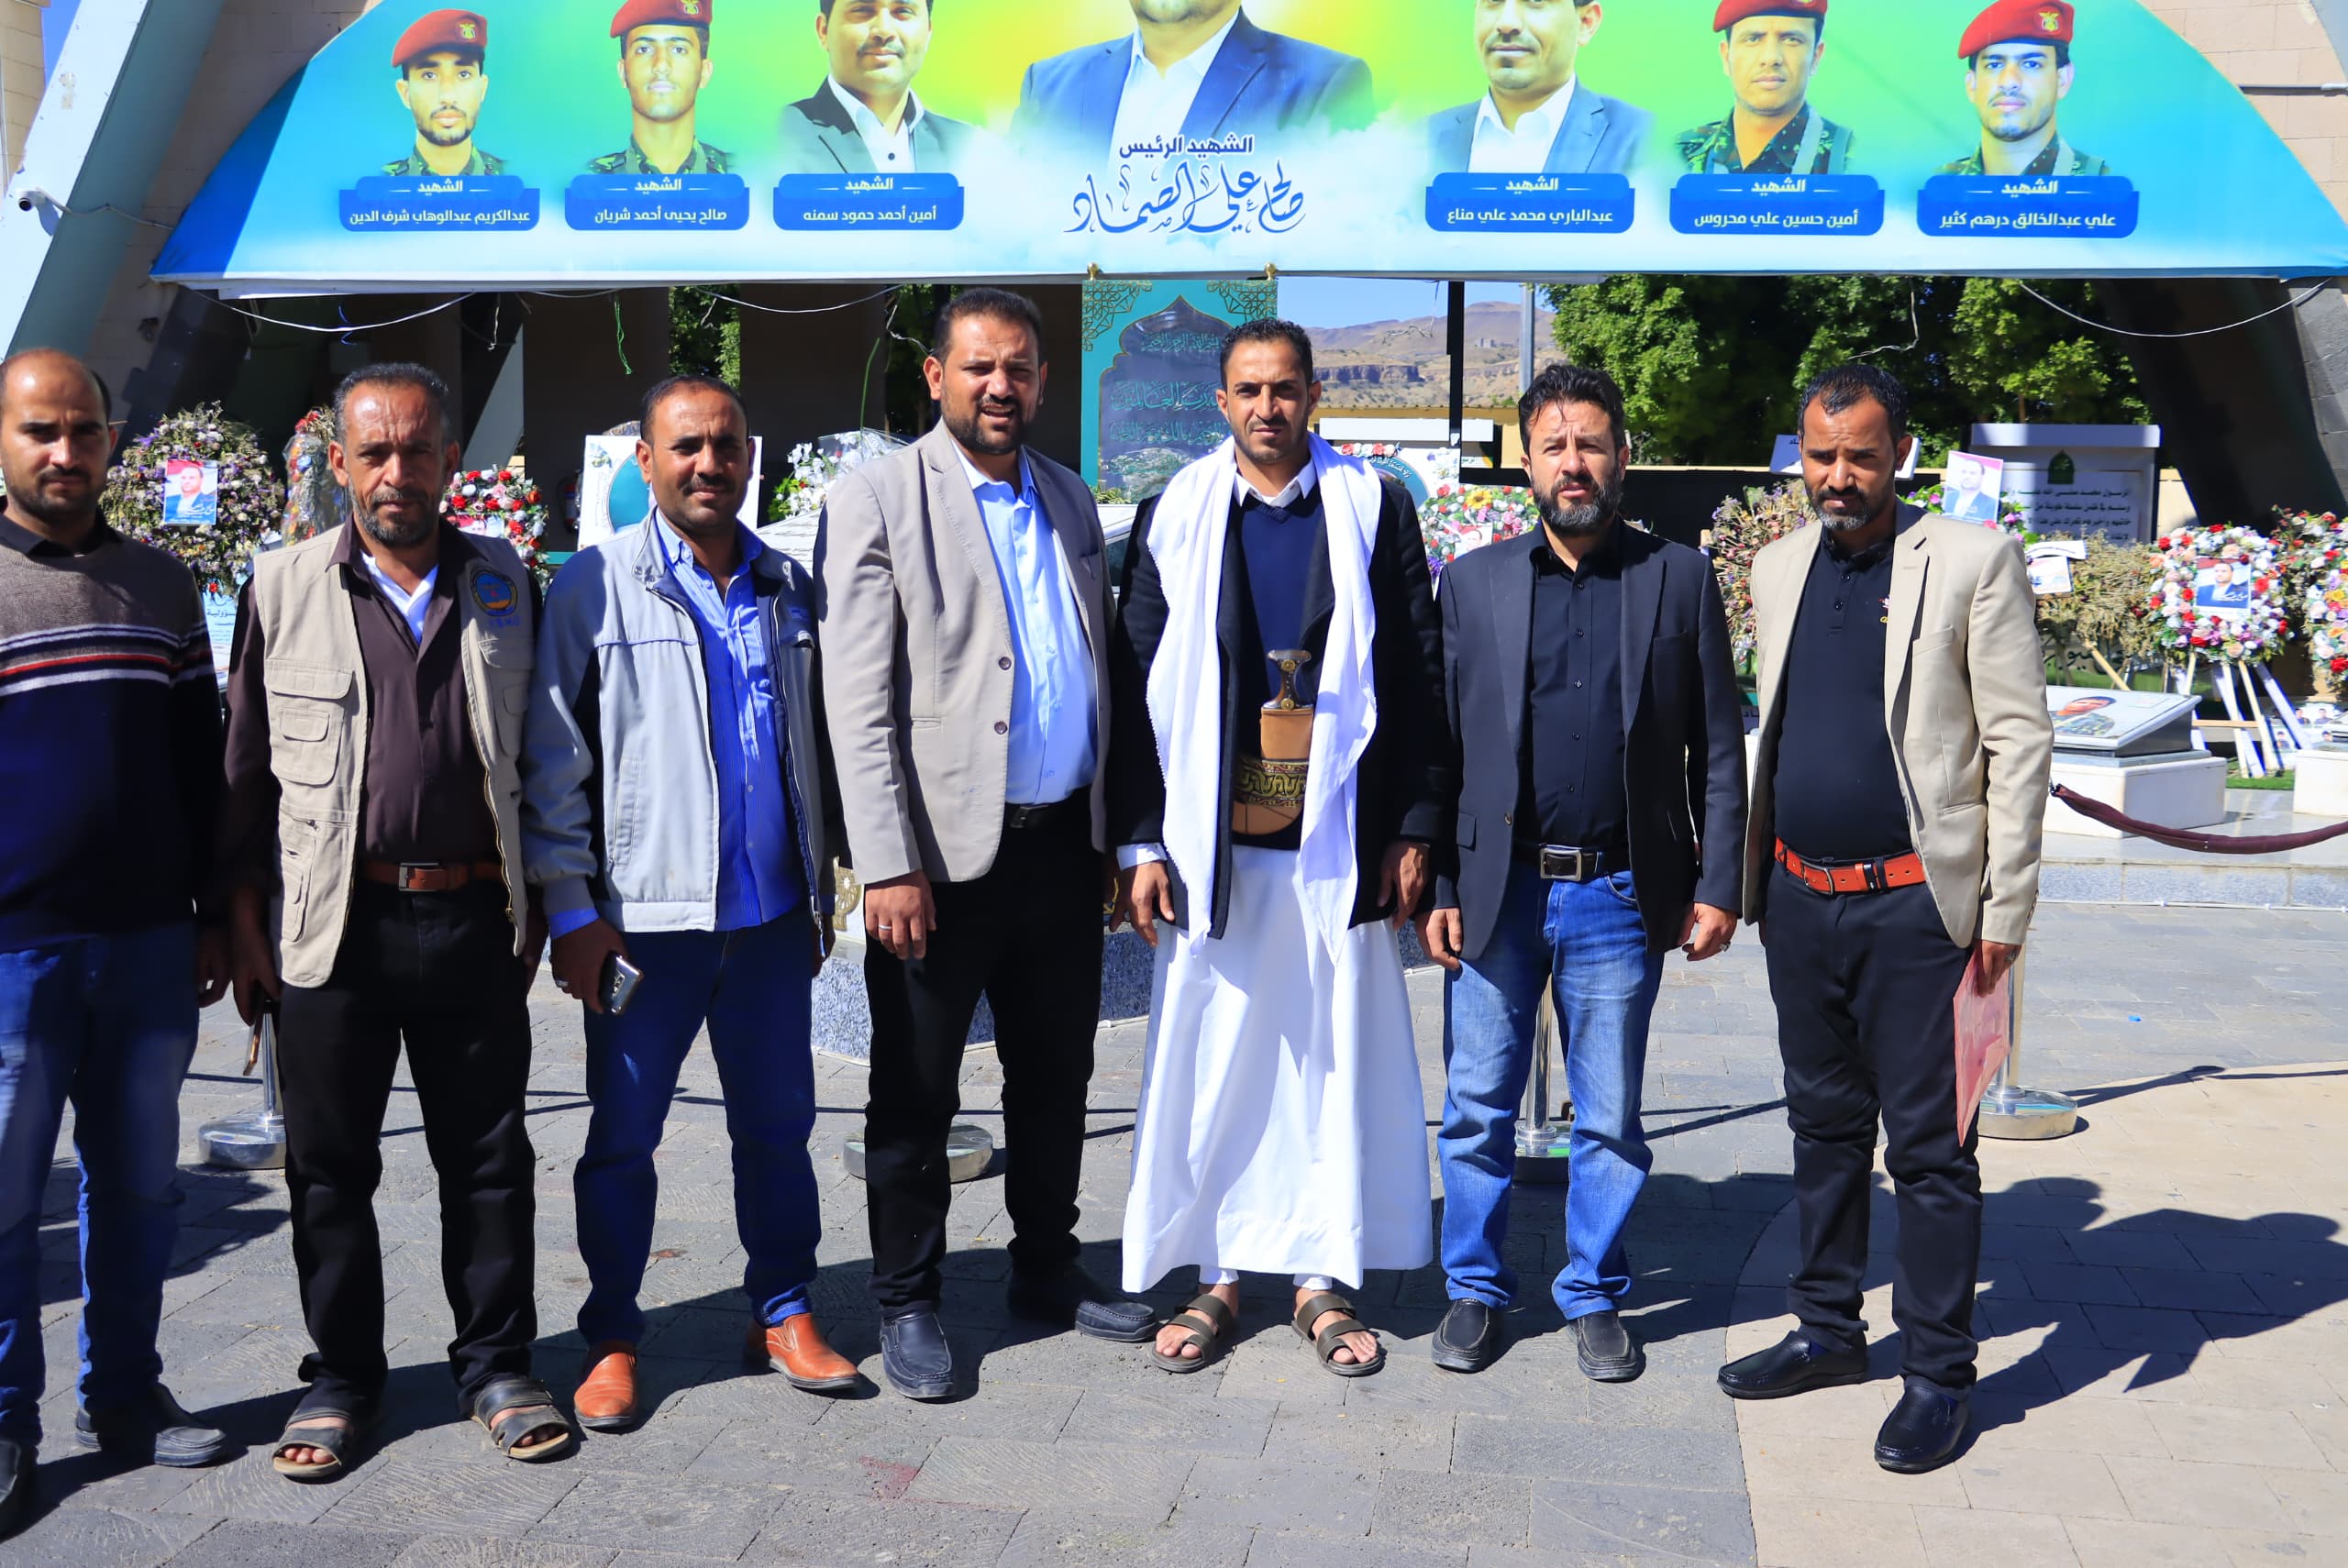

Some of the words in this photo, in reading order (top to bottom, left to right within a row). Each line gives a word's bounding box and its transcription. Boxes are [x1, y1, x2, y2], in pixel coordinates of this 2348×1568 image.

[1119, 136, 1182, 159] الرئيس
[1187, 134, 1253, 158] الشهيد
[417, 178, 463, 196] الشهيد
[635, 176, 681, 194] الشهيد
[845, 175, 894, 194] الشهيد
[1505, 175, 1559, 194] الشهيد
[1751, 176, 1806, 196] الشهيد
[2001, 178, 2059, 198] الشهيد
[1064, 160, 1194, 233] الصماد
[1183, 161, 1262, 233] علي
[1258, 160, 1306, 233] صالح
[349, 210, 379, 225] الدين
[382, 209, 409, 225] شرف
[413, 209, 472, 225] عبدالوهاب
[474, 209, 530, 225] عبدالكريم
[594, 207, 631, 224] شريان
[634, 205, 661, 221] أحمد
[664, 211, 697, 224] يحيى
[699, 208, 727, 225] صالح
[803, 209, 838, 221] سمنه
[841, 211, 874, 224] حمود
[877, 205, 906, 221] أحمد
[908, 205, 937, 223] أمين
[1447, 208, 1475, 224] مناع
[1478, 208, 1506, 224] علي
[1510, 210, 1545, 221] محمد
[1549, 209, 1613, 225] عبدالباري
[1694, 214, 1746, 227] محروس
[1750, 212, 1779, 227] علي
[1783, 214, 1823, 227] حسين
[1826, 208, 1859, 227] أمين
[1939, 210, 1967, 228] كثير
[2012, 212, 2082, 229] عبدالخالق
[2080, 213, 2117, 228] علي
[1970, 214, 2010, 229] درهم
